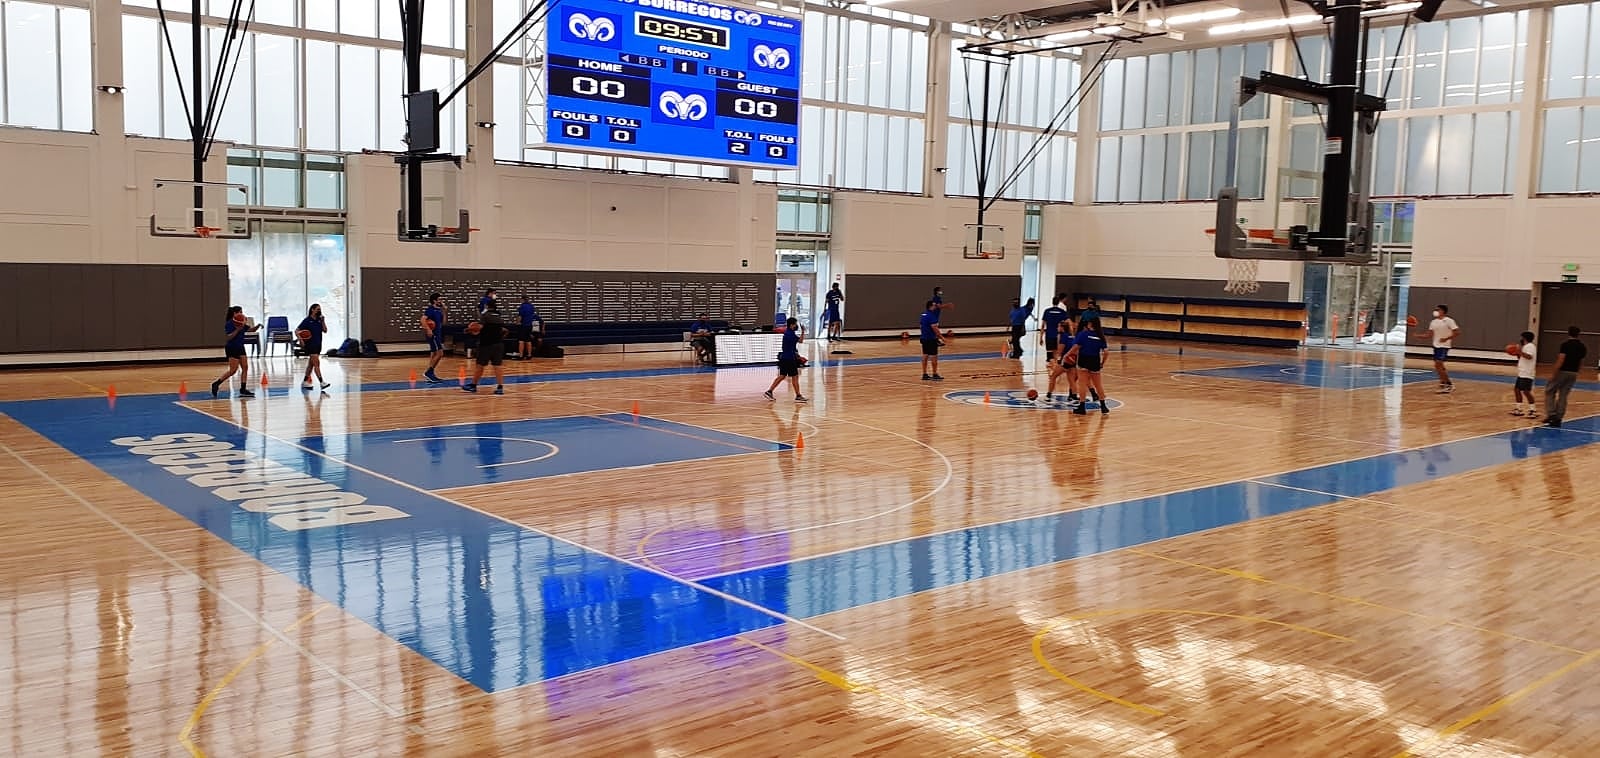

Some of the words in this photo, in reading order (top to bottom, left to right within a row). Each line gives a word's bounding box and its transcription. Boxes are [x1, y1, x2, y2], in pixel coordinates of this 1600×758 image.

[644, 20, 718, 44] 09:57
[659, 45, 709, 59] PERIODO
[578, 59, 623, 72] HOME
[681, 62, 687, 72] 1
[572, 76, 625, 99] 00
[737, 82, 778, 95] GUEST
[734, 98, 778, 118] 00
[552, 110, 599, 123] FOULS
[606, 116, 639, 127] T.O.L
[566, 125, 584, 137] 0
[613, 130, 630, 141] 0
[725, 130, 753, 140] T.O.L
[759, 134, 795, 144] FOULS
[730, 142, 745, 153] 2
[769, 146, 783, 157] 0
[110, 433, 412, 531] BORREGOS
